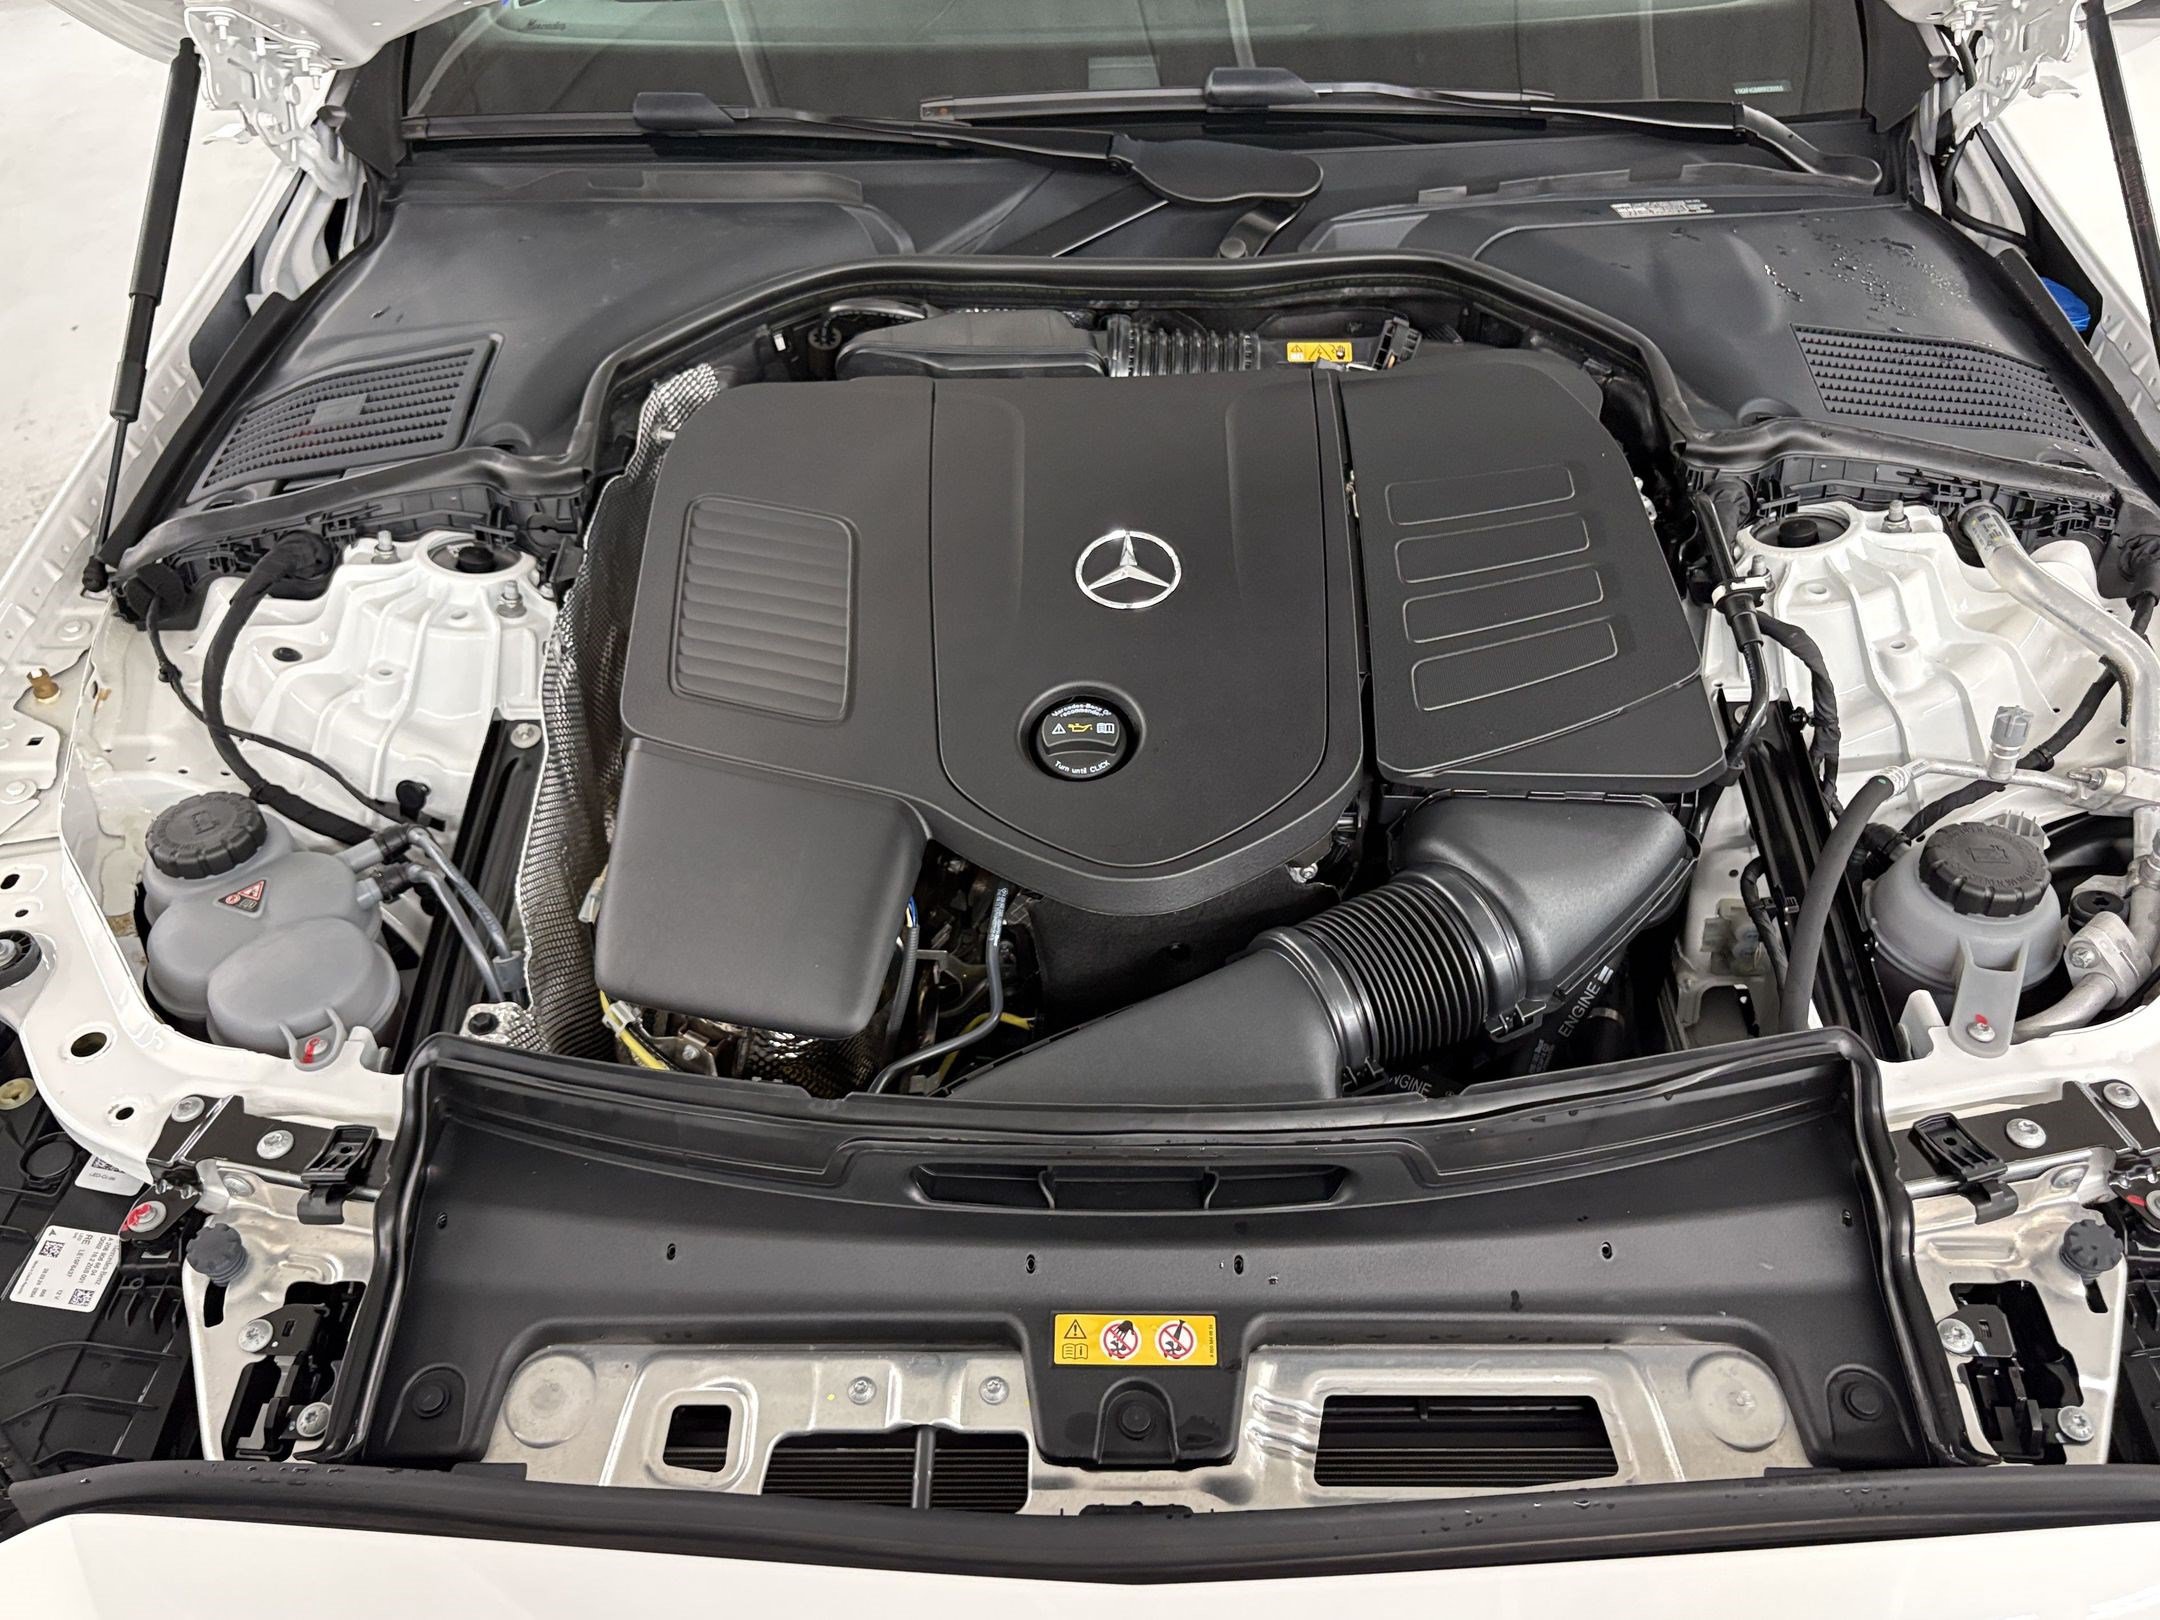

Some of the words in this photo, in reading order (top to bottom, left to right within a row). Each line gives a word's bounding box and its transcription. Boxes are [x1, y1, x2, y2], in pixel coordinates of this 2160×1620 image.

[1051, 703, 1103, 716] Mercedes-Benz
[1055, 760, 1070, 772] Turn
[1089, 760, 1111, 773] CLICK
[1558, 981, 1601, 1038] ENGINE
[1389, 1074, 1432, 1096] NGINE
